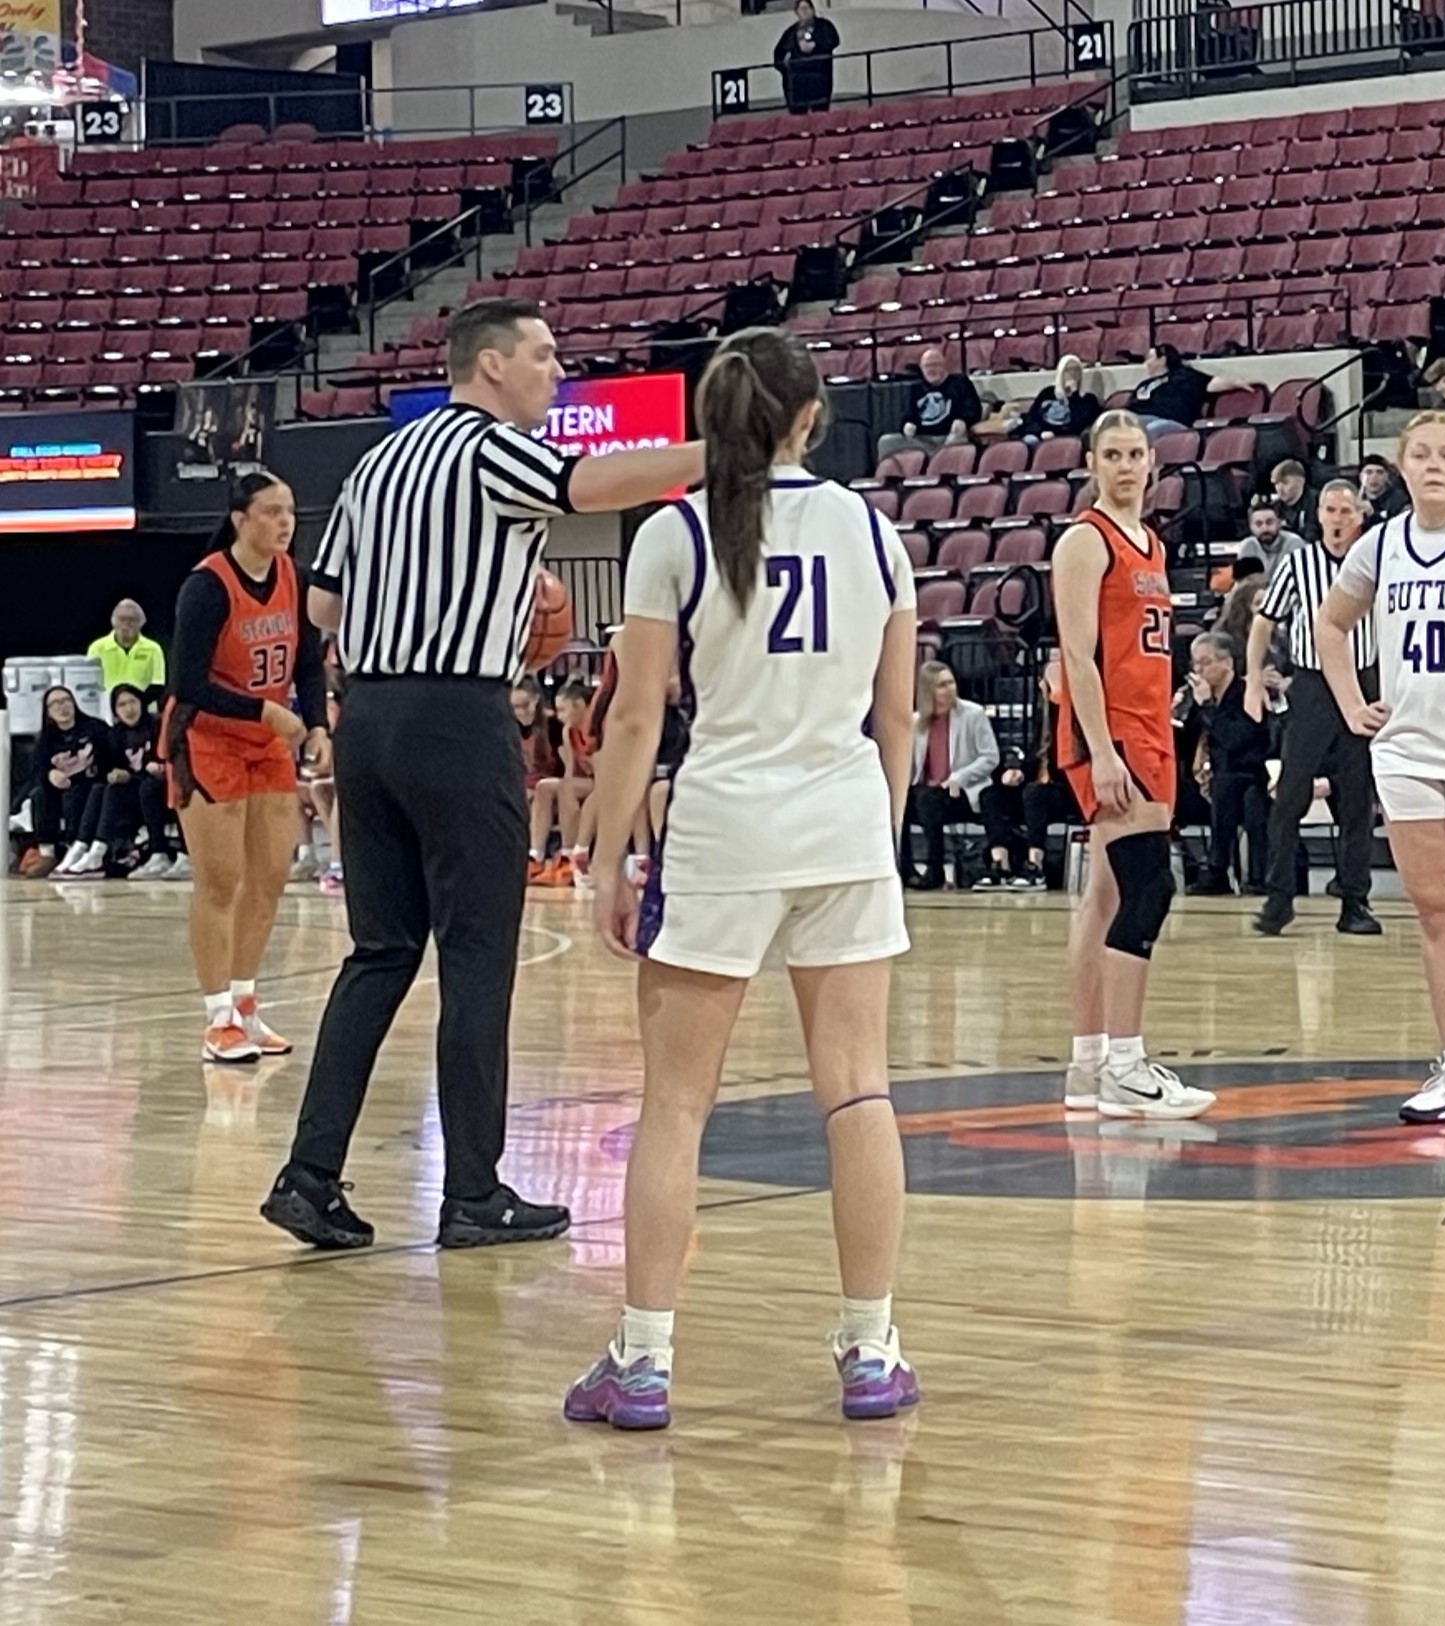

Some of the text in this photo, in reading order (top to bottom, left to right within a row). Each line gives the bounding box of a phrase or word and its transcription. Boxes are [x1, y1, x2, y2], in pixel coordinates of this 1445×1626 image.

[1078, 34, 1102, 61] 21
[723, 79, 745, 104] 21
[528, 93, 561, 118] 23
[85, 111, 119, 135] 23
[765, 555, 828, 654] 21
[248, 643, 290, 691] 33
